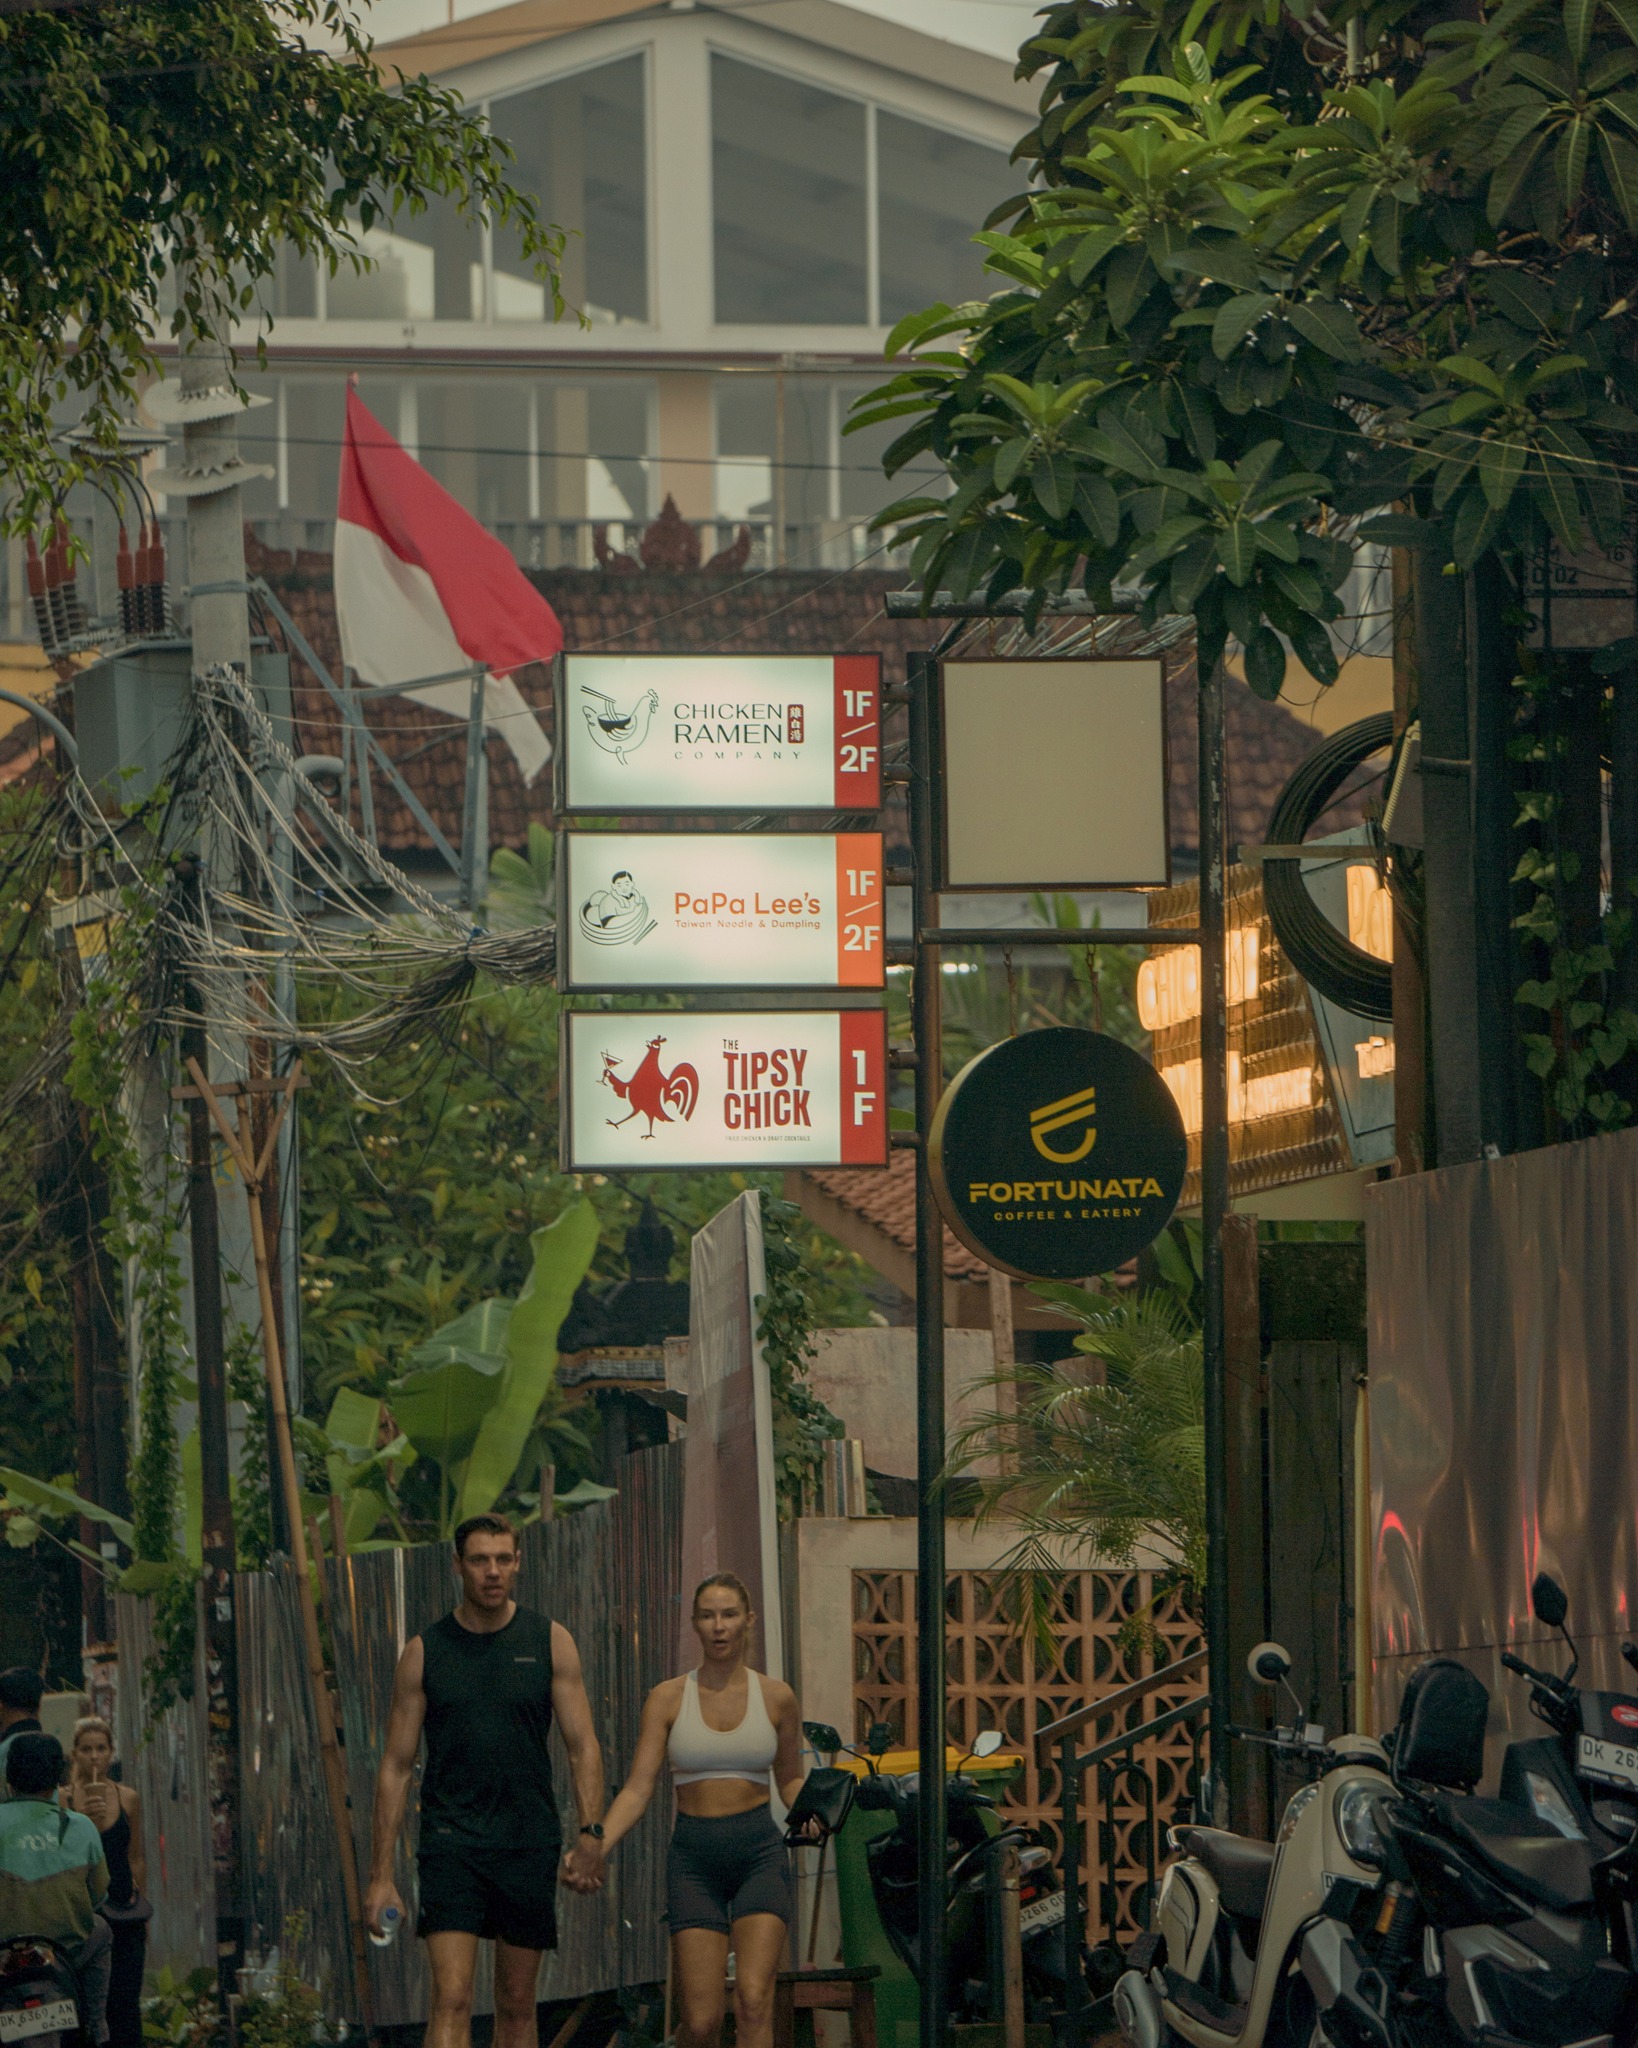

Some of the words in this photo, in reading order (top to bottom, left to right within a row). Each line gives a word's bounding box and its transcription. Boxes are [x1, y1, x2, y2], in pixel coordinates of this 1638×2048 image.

[674, 703, 783, 720] CHICKEN
[843, 690, 874, 717] 1F
[674, 723, 783, 744] RAMEN
[674, 751, 801, 760] COMPANY
[840, 746, 877, 772] 2F
[847, 870, 876, 896] 1F
[674, 892, 745, 915] PaPa
[754, 891, 821, 915] Lee's
[674, 919, 713, 929] Taiwan
[717, 919, 754, 929] Noodle
[758, 919, 767, 929] &
[771, 919, 821, 931] Dumpling
[843, 925, 880, 951] 2F
[722, 1039, 739, 1050] THE
[722, 1049, 808, 1091] TIPSY
[723, 1089, 812, 1130] CHICK
[969, 1177, 1165, 1203] FORTUNATA
[994, 1210, 1056, 1222] COFFEE
[1063, 1209, 1073, 1219] &
[1082, 1207, 1142, 1219] EATERY
[1583, 1738, 1604, 1760] DK
[1614, 1749, 1638, 1771] 26
[0, 2014, 15, 2027] DK
[58, 2003, 73, 2014] AN
